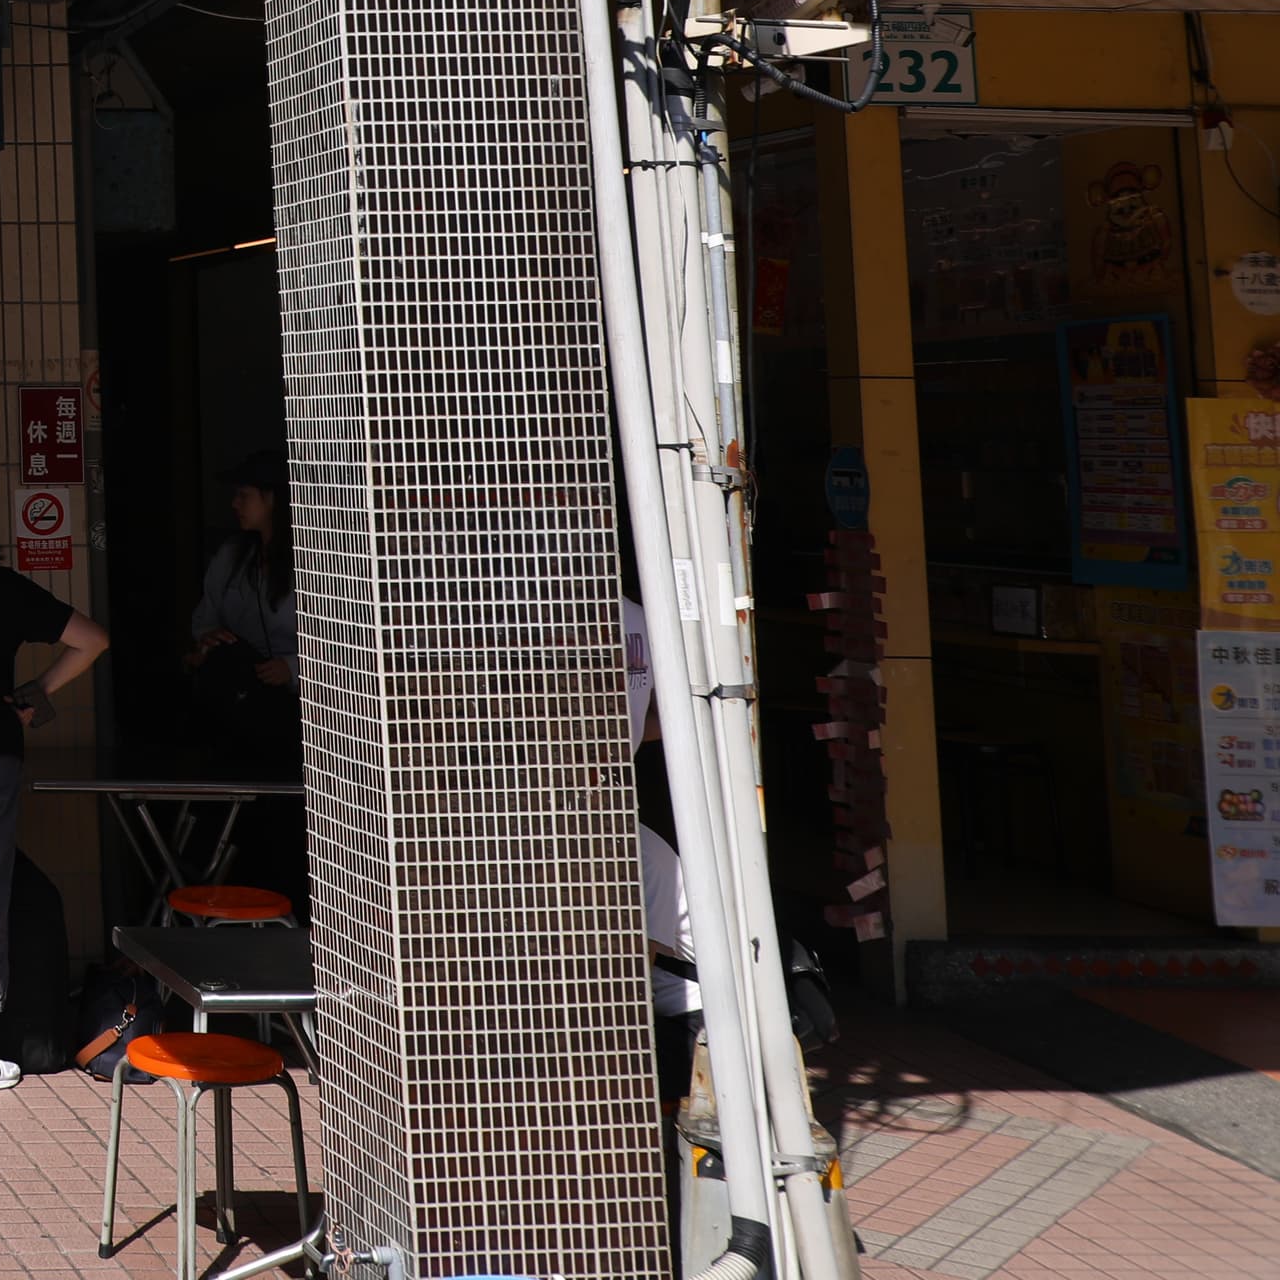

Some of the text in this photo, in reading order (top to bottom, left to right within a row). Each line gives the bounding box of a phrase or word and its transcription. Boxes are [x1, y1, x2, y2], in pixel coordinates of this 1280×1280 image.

[862, 50, 962, 93] 232
[27, 421, 49, 476] 休息
[55, 396, 79, 459] 每週一
